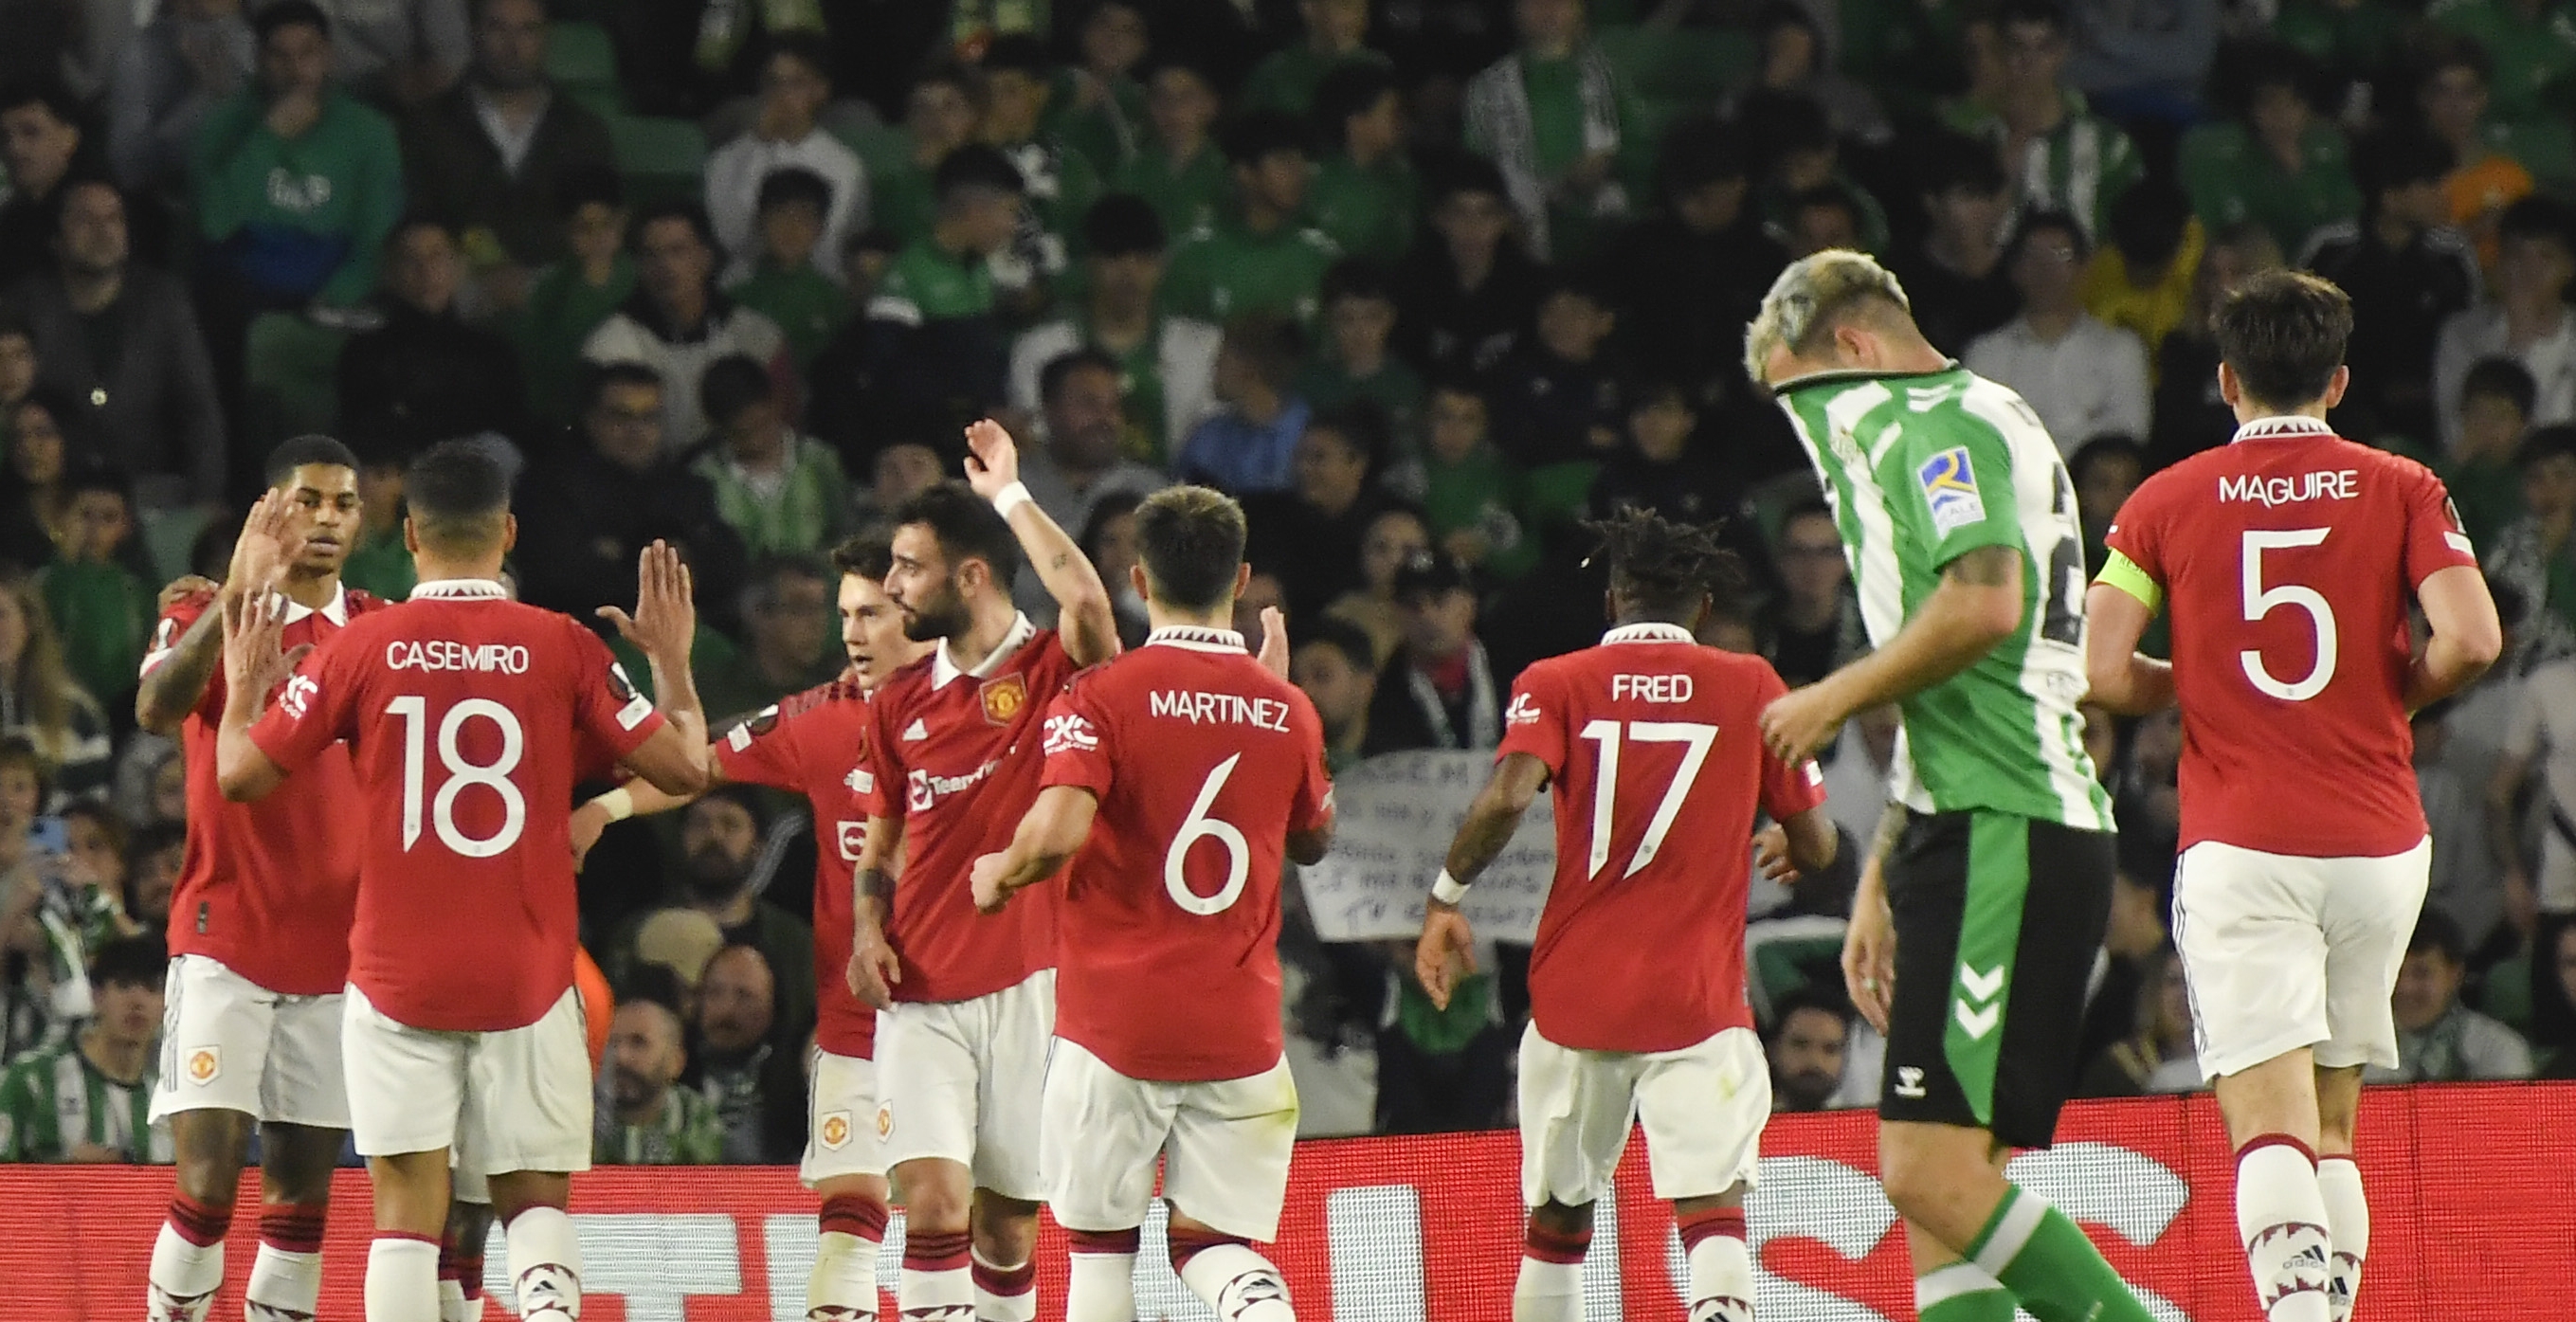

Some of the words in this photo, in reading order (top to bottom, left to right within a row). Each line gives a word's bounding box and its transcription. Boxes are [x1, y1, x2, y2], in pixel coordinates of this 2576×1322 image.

[2218, 468, 2360, 510] MAGUIRE
[385, 639, 530, 676] CASEMIRO
[2239, 525, 2338, 703] 5
[1149, 688, 1291, 734] MARTINEZ
[1611, 673, 1695, 704] FRED
[384, 694, 527, 859] 18
[1579, 718, 1720, 882] 17
[1163, 751, 1251, 916] 6
